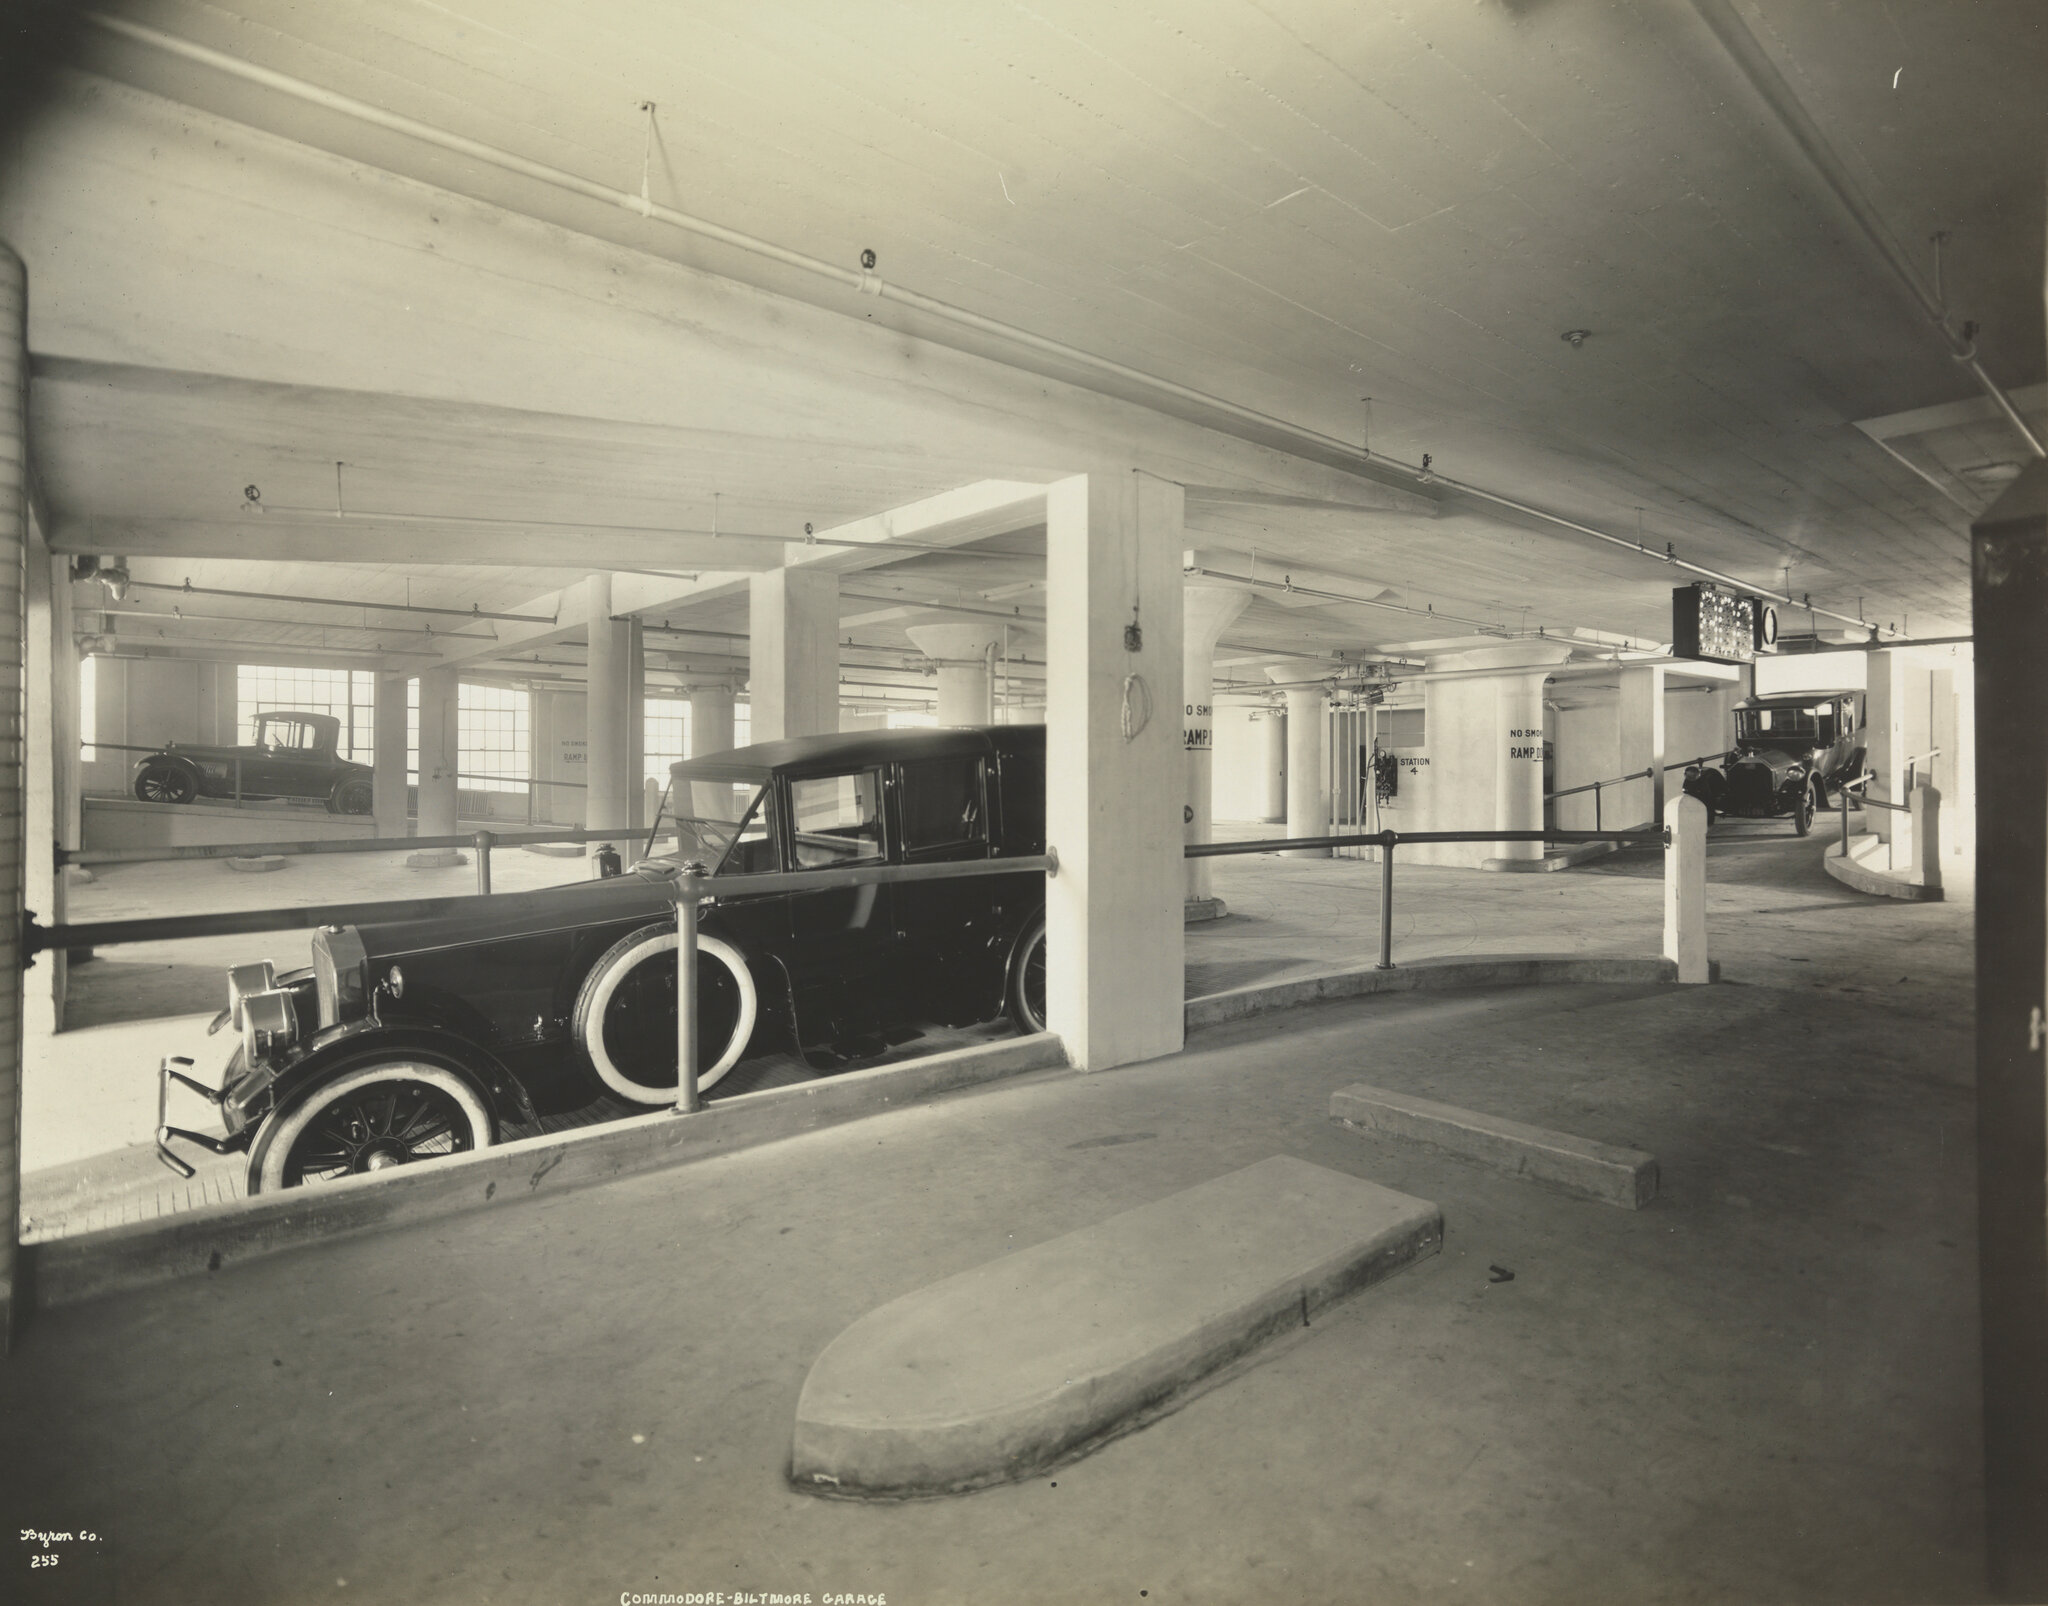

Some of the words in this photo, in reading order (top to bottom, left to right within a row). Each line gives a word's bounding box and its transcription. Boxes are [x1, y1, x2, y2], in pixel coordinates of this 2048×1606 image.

[1510, 729, 1523, 738] NO
[563, 753, 582, 761] RAMP
[1510, 747, 1535, 759] RAMP
[1400, 758, 1430, 766] STATION
[1410, 766, 1419, 775] 4
